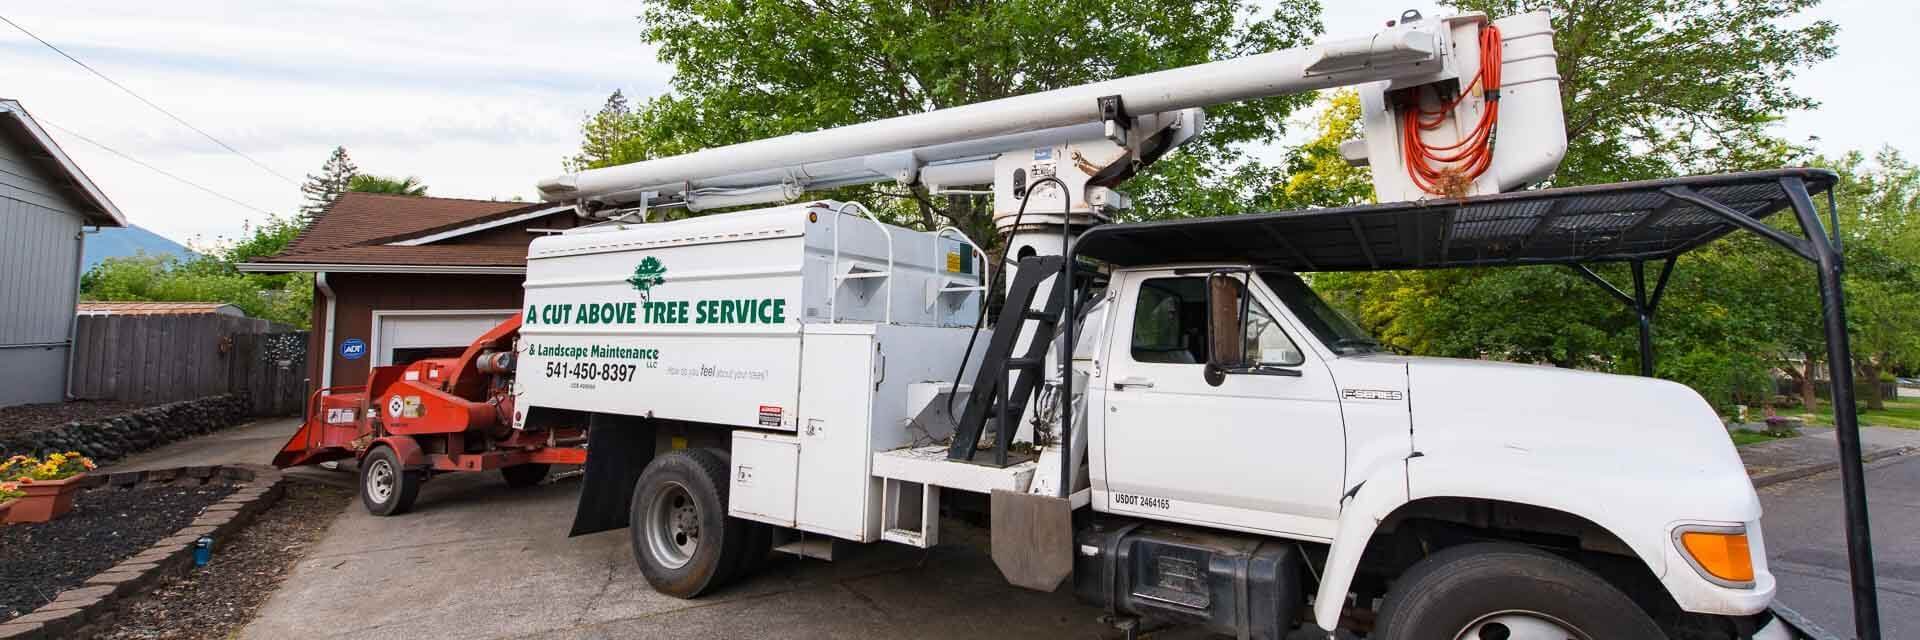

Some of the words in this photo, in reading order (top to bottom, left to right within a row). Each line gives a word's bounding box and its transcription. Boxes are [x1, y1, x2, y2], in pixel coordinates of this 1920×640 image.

[526, 304, 537, 325] A
[542, 303, 573, 325] CUT
[575, 302, 637, 325] ABOVE
[642, 301, 690, 325] TREE
[695, 298, 786, 325] SERVICE
[344, 345, 362, 353] ADT
[528, 343, 536, 356] &
[537, 344, 589, 360] Landscape
[590, 344, 660, 360] Maintenance
[545, 361, 637, 383] 541-450-8397
[646, 361, 658, 369] LLC
[700, 363, 717, 377] feel
[1115, 493, 1139, 506] USDOT
[1140, 496, 1170, 510] 2464165
